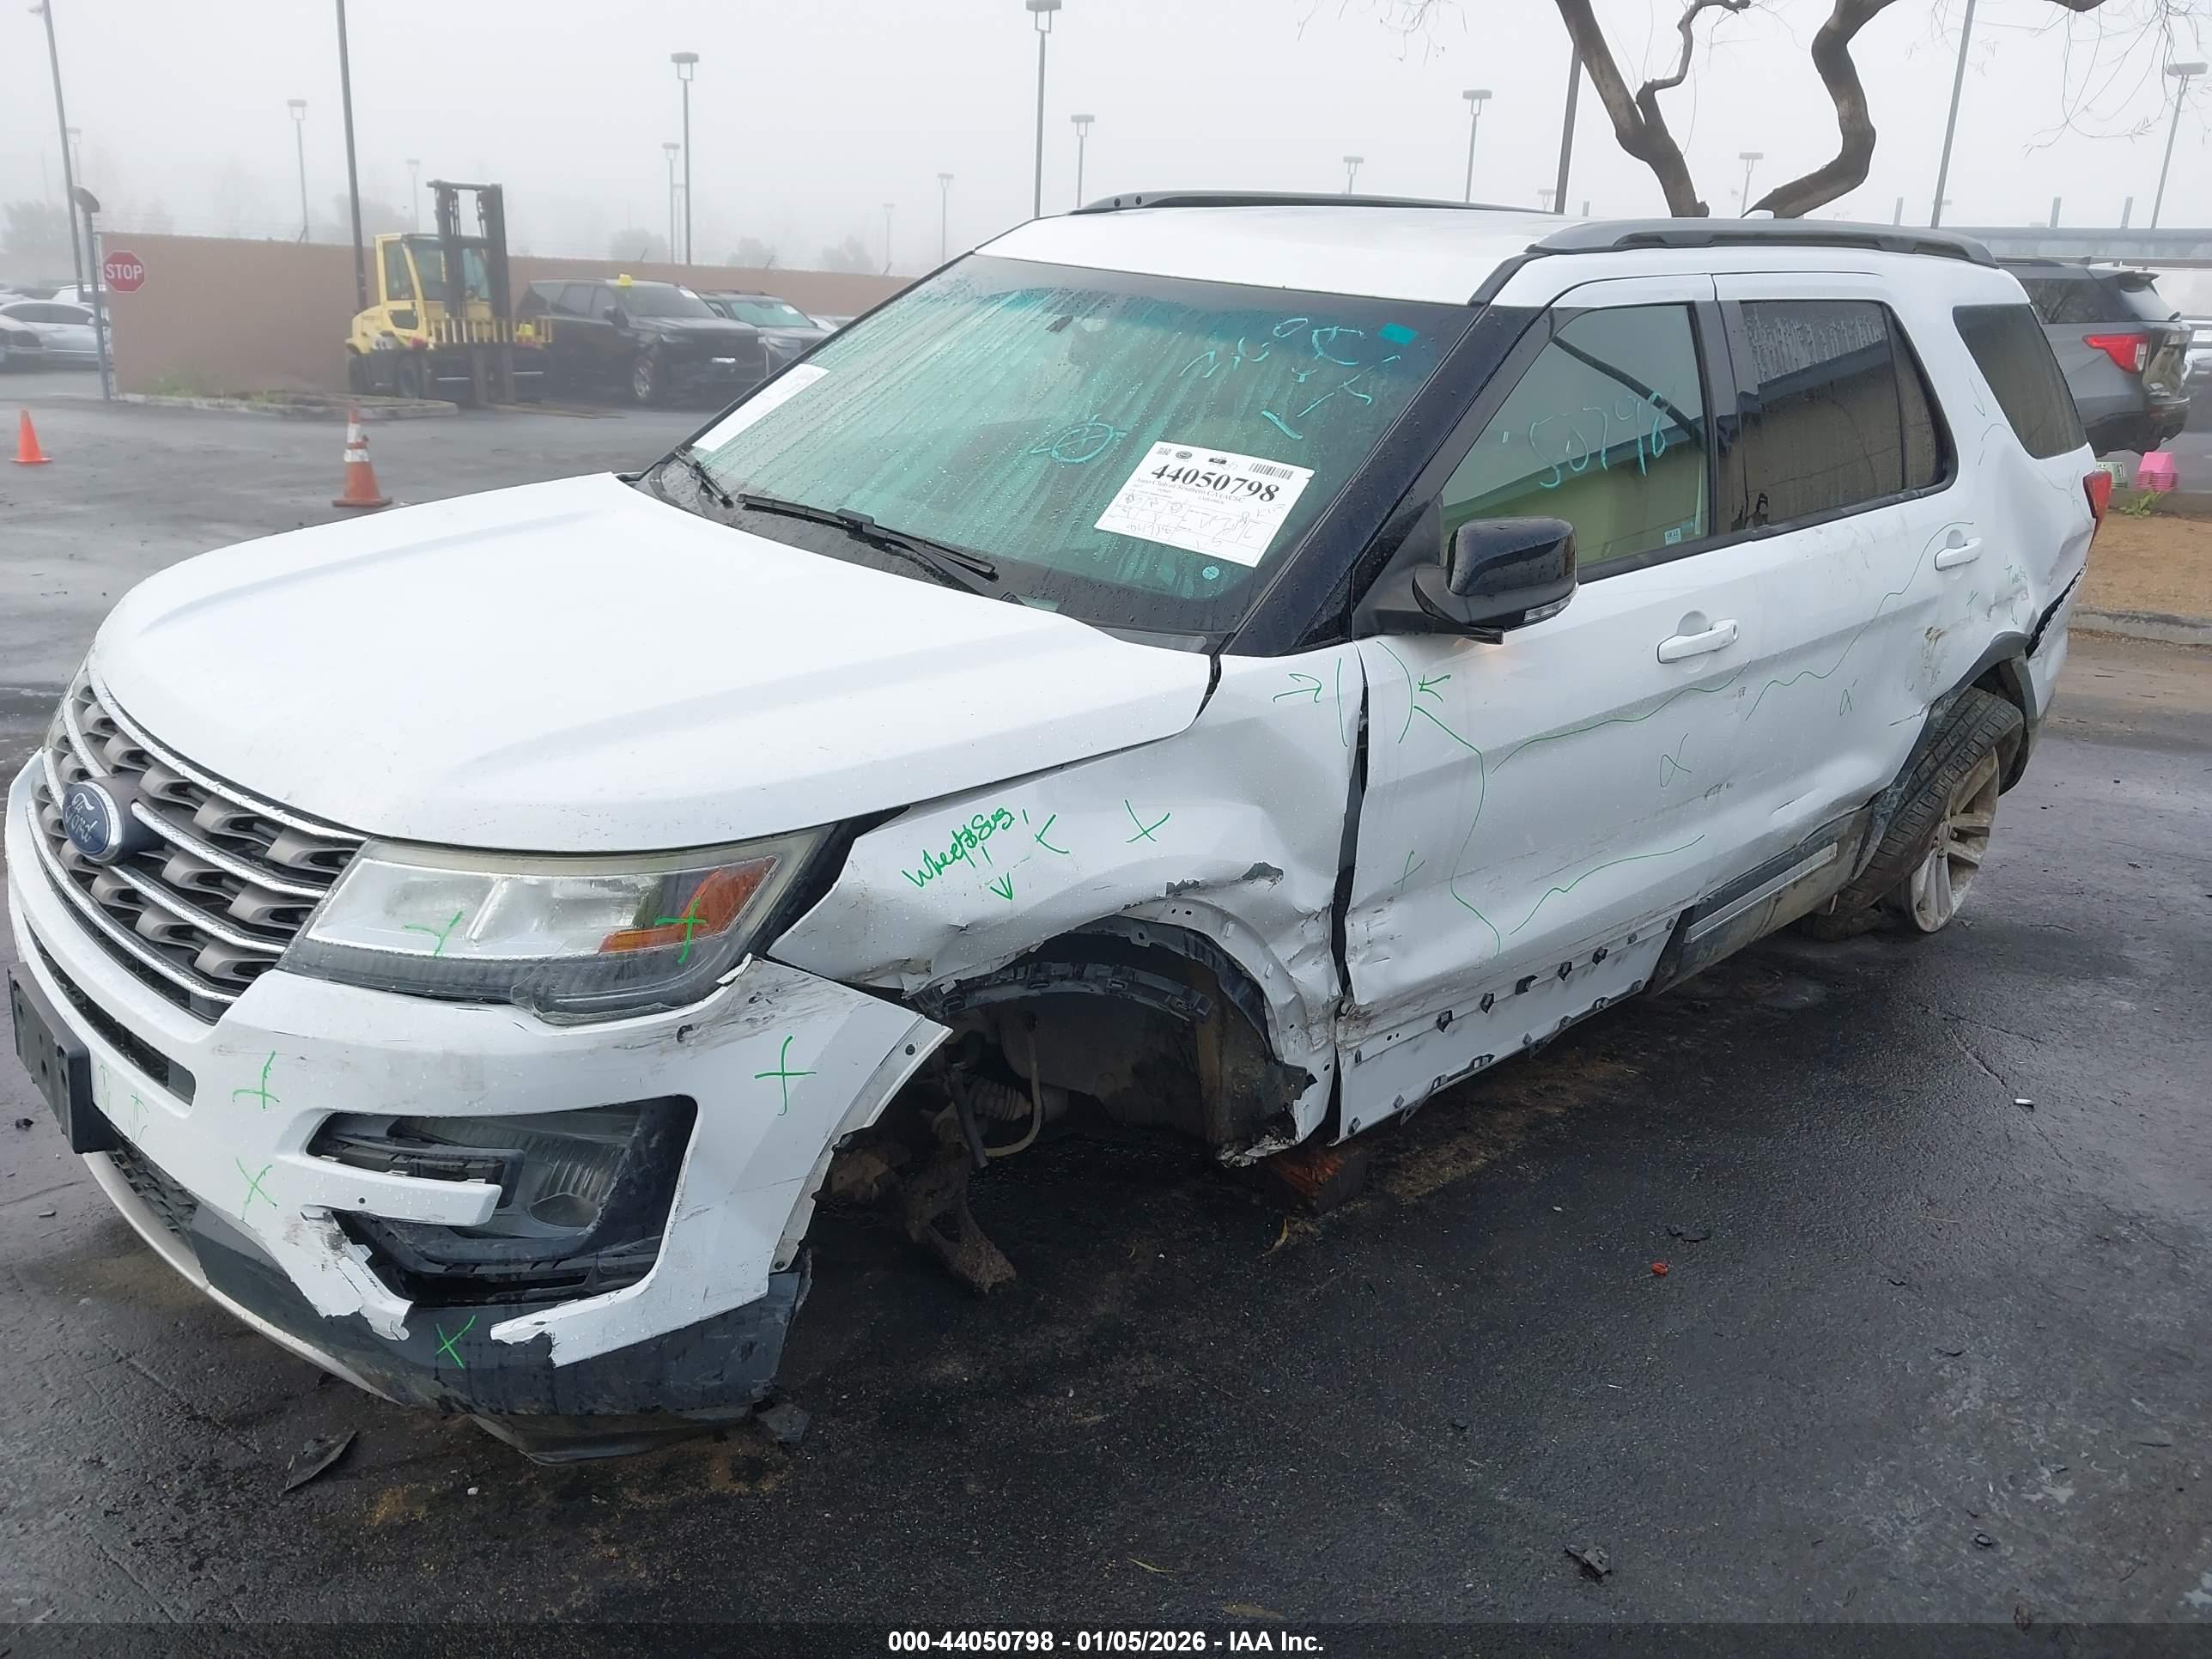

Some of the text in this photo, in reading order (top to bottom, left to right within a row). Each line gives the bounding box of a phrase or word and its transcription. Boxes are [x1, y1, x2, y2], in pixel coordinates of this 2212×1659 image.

[106, 264, 143, 280] STOP
[1152, 465, 1279, 501] 44050798
[65, 793, 98, 842] Ford
